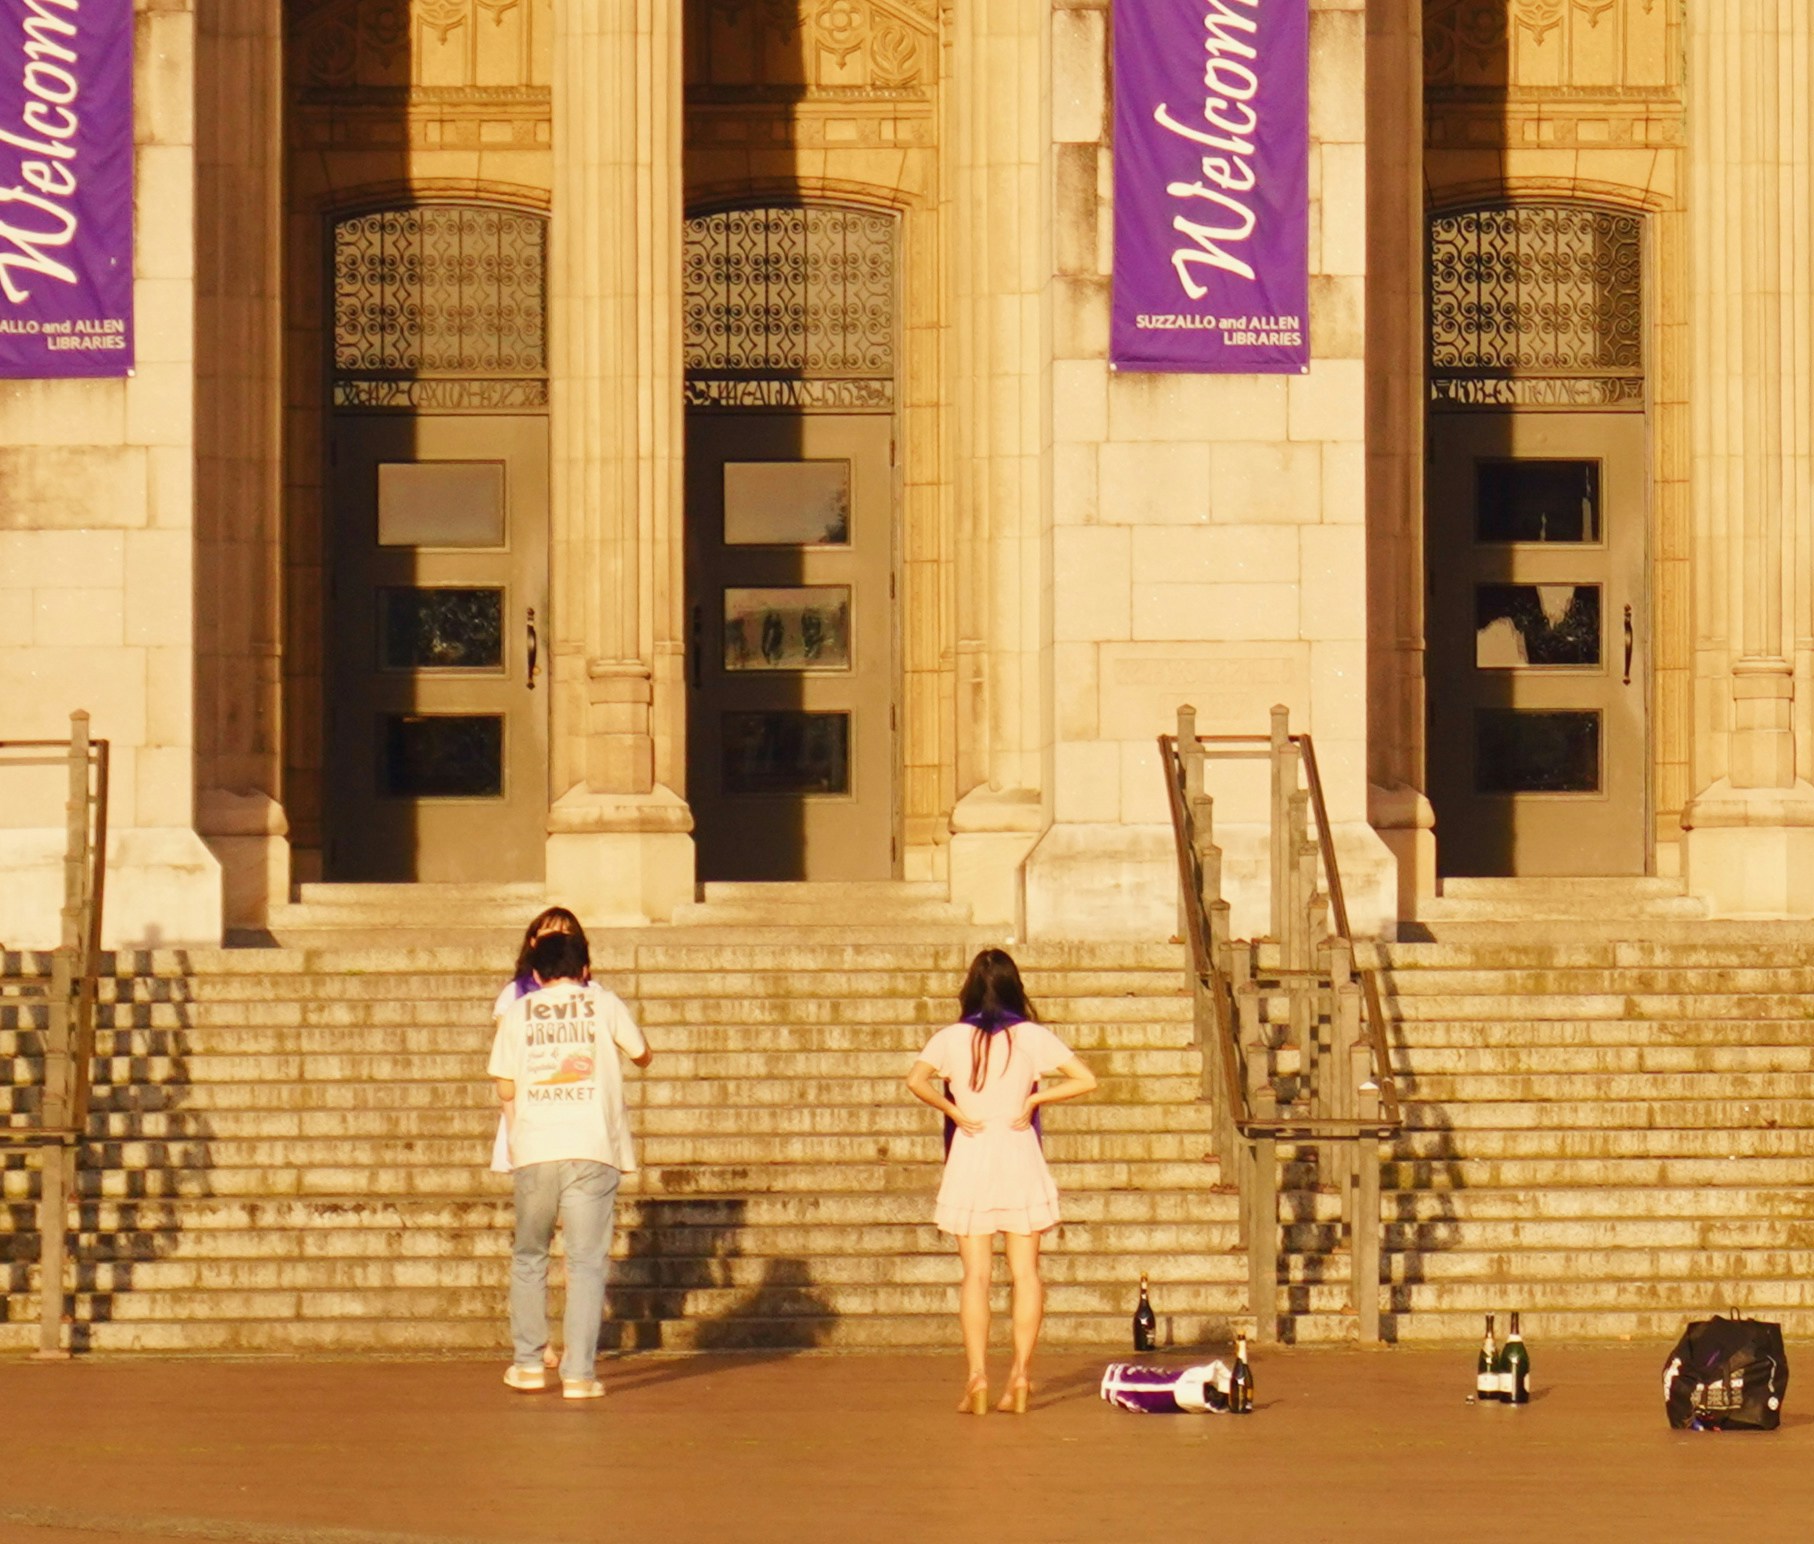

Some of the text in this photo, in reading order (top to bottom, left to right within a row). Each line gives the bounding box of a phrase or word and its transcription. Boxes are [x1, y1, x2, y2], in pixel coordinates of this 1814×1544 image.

[41, 320, 72, 334] and
[74, 319, 125, 333] ALLEN
[1136, 314, 1299, 330] SUZZALLO and ALLEN
[47, 335, 126, 350] LIBRARIES
[1223, 331, 1302, 346] LIBRARIES
[525, 993, 596, 1022] levi's
[526, 1021, 596, 1047] ORGANIC
[527, 1087, 596, 1102] MARKET
